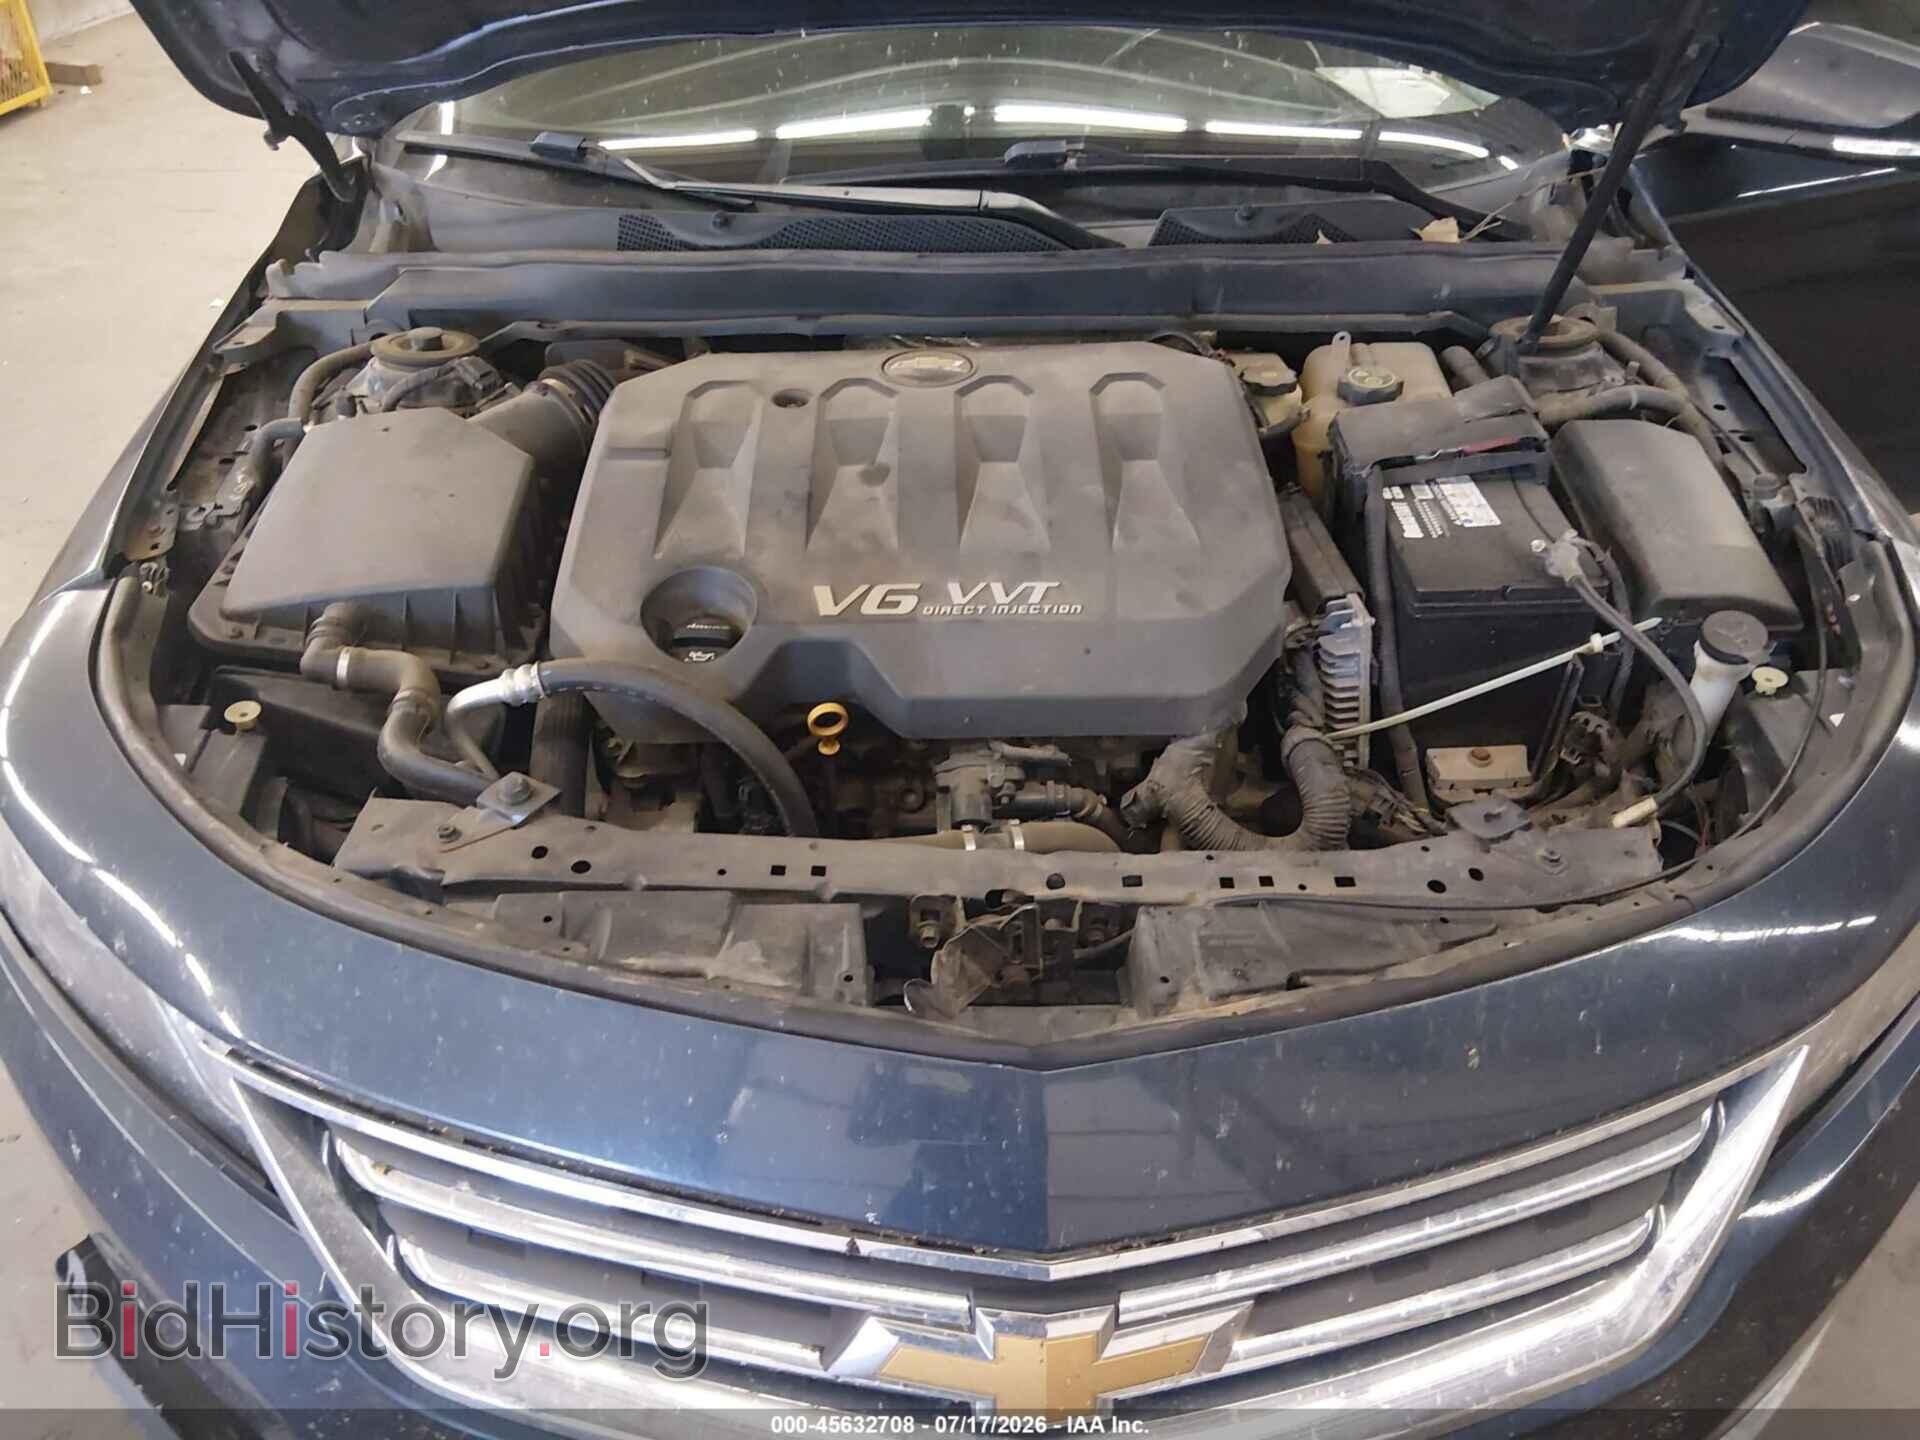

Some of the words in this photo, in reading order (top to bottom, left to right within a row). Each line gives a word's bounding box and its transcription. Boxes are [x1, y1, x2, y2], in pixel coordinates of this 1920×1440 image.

[813, 583, 921, 616] V6
[947, 581, 1061, 604] VVT
[922, 605, 990, 615] DIRECT
[991, 604, 1083, 615] INJECTION
